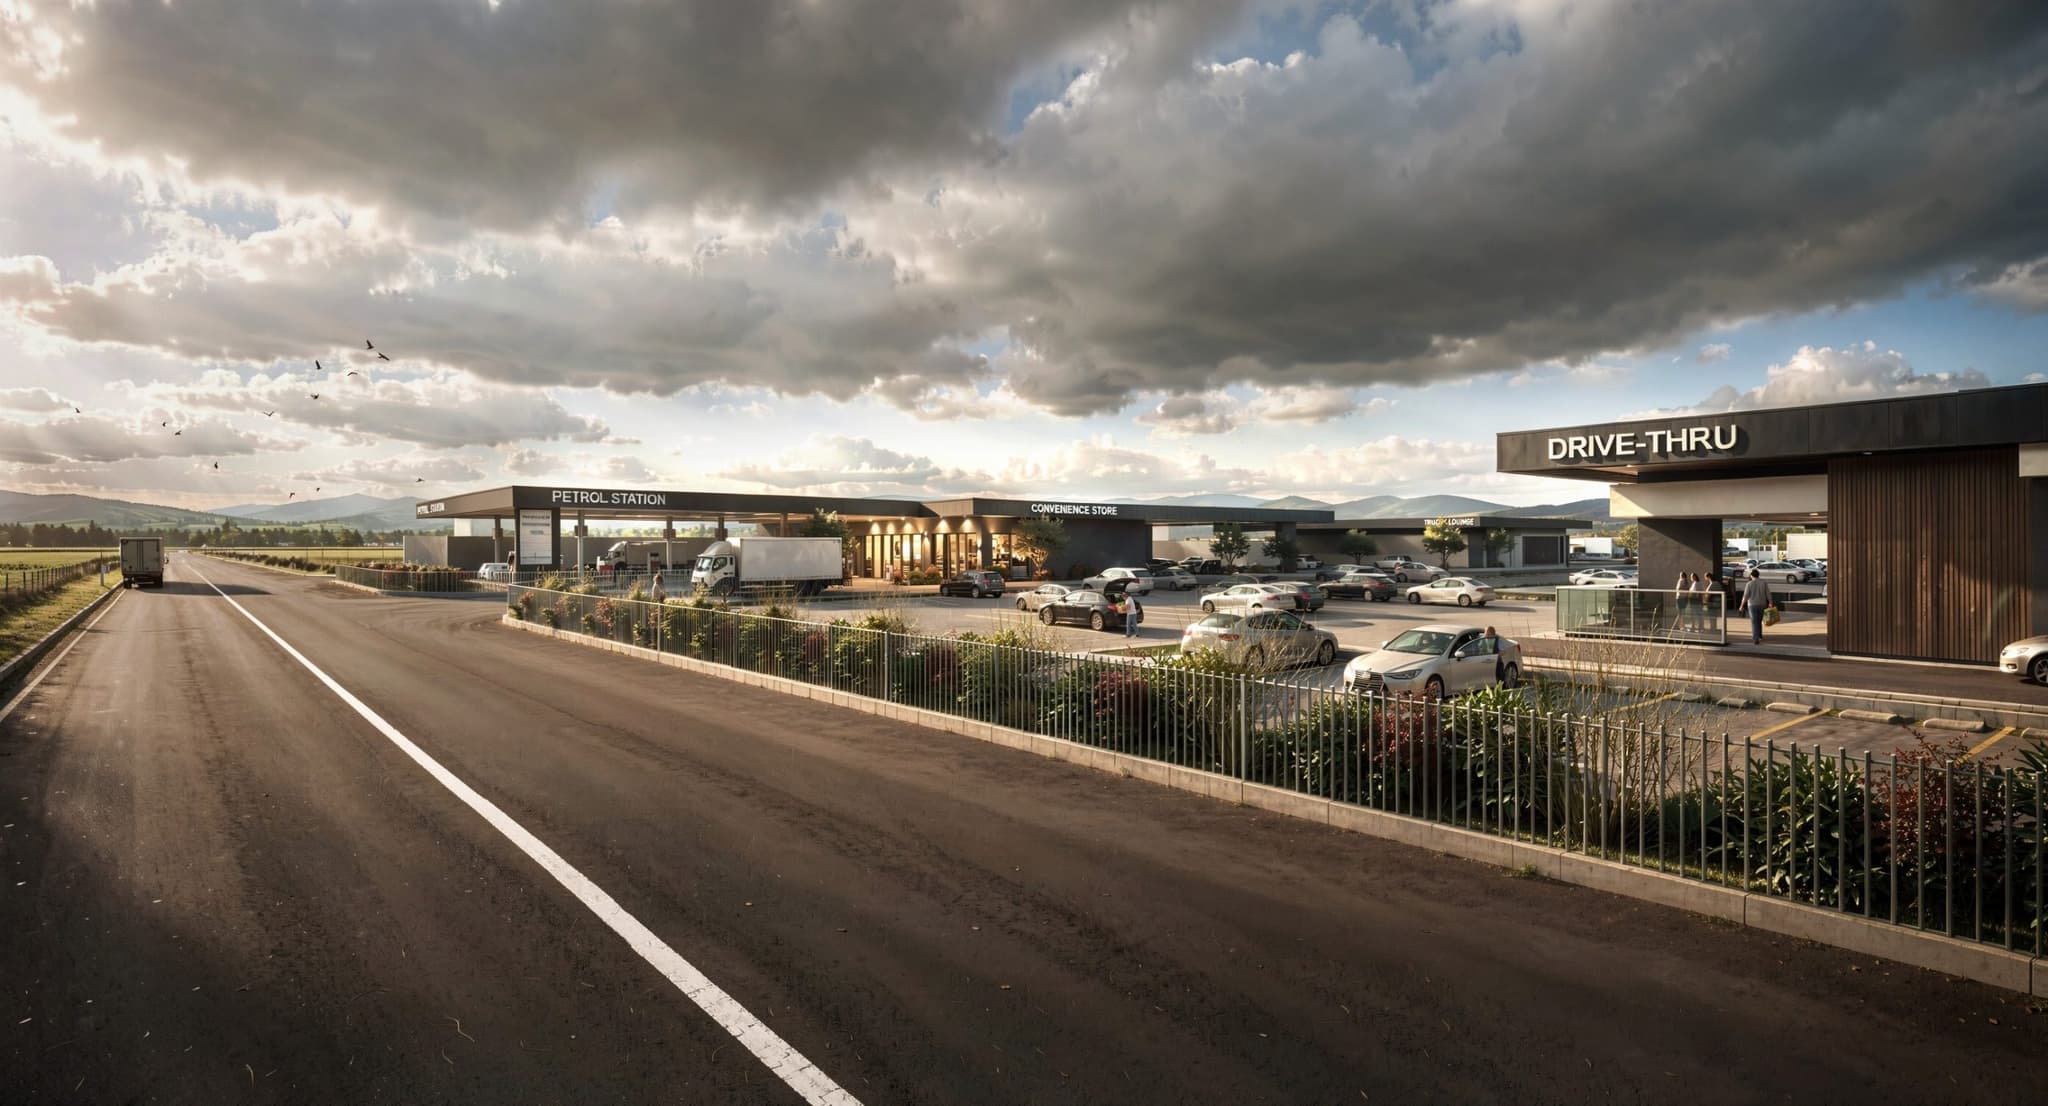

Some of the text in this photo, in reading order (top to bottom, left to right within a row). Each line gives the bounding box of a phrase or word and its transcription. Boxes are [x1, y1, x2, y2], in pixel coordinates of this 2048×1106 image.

[1548, 424, 1737, 460] DRIVE-THRU
[552, 490, 666, 505] PETROL STATION
[1031, 503, 1118, 515] CONVENIENCE STORE
